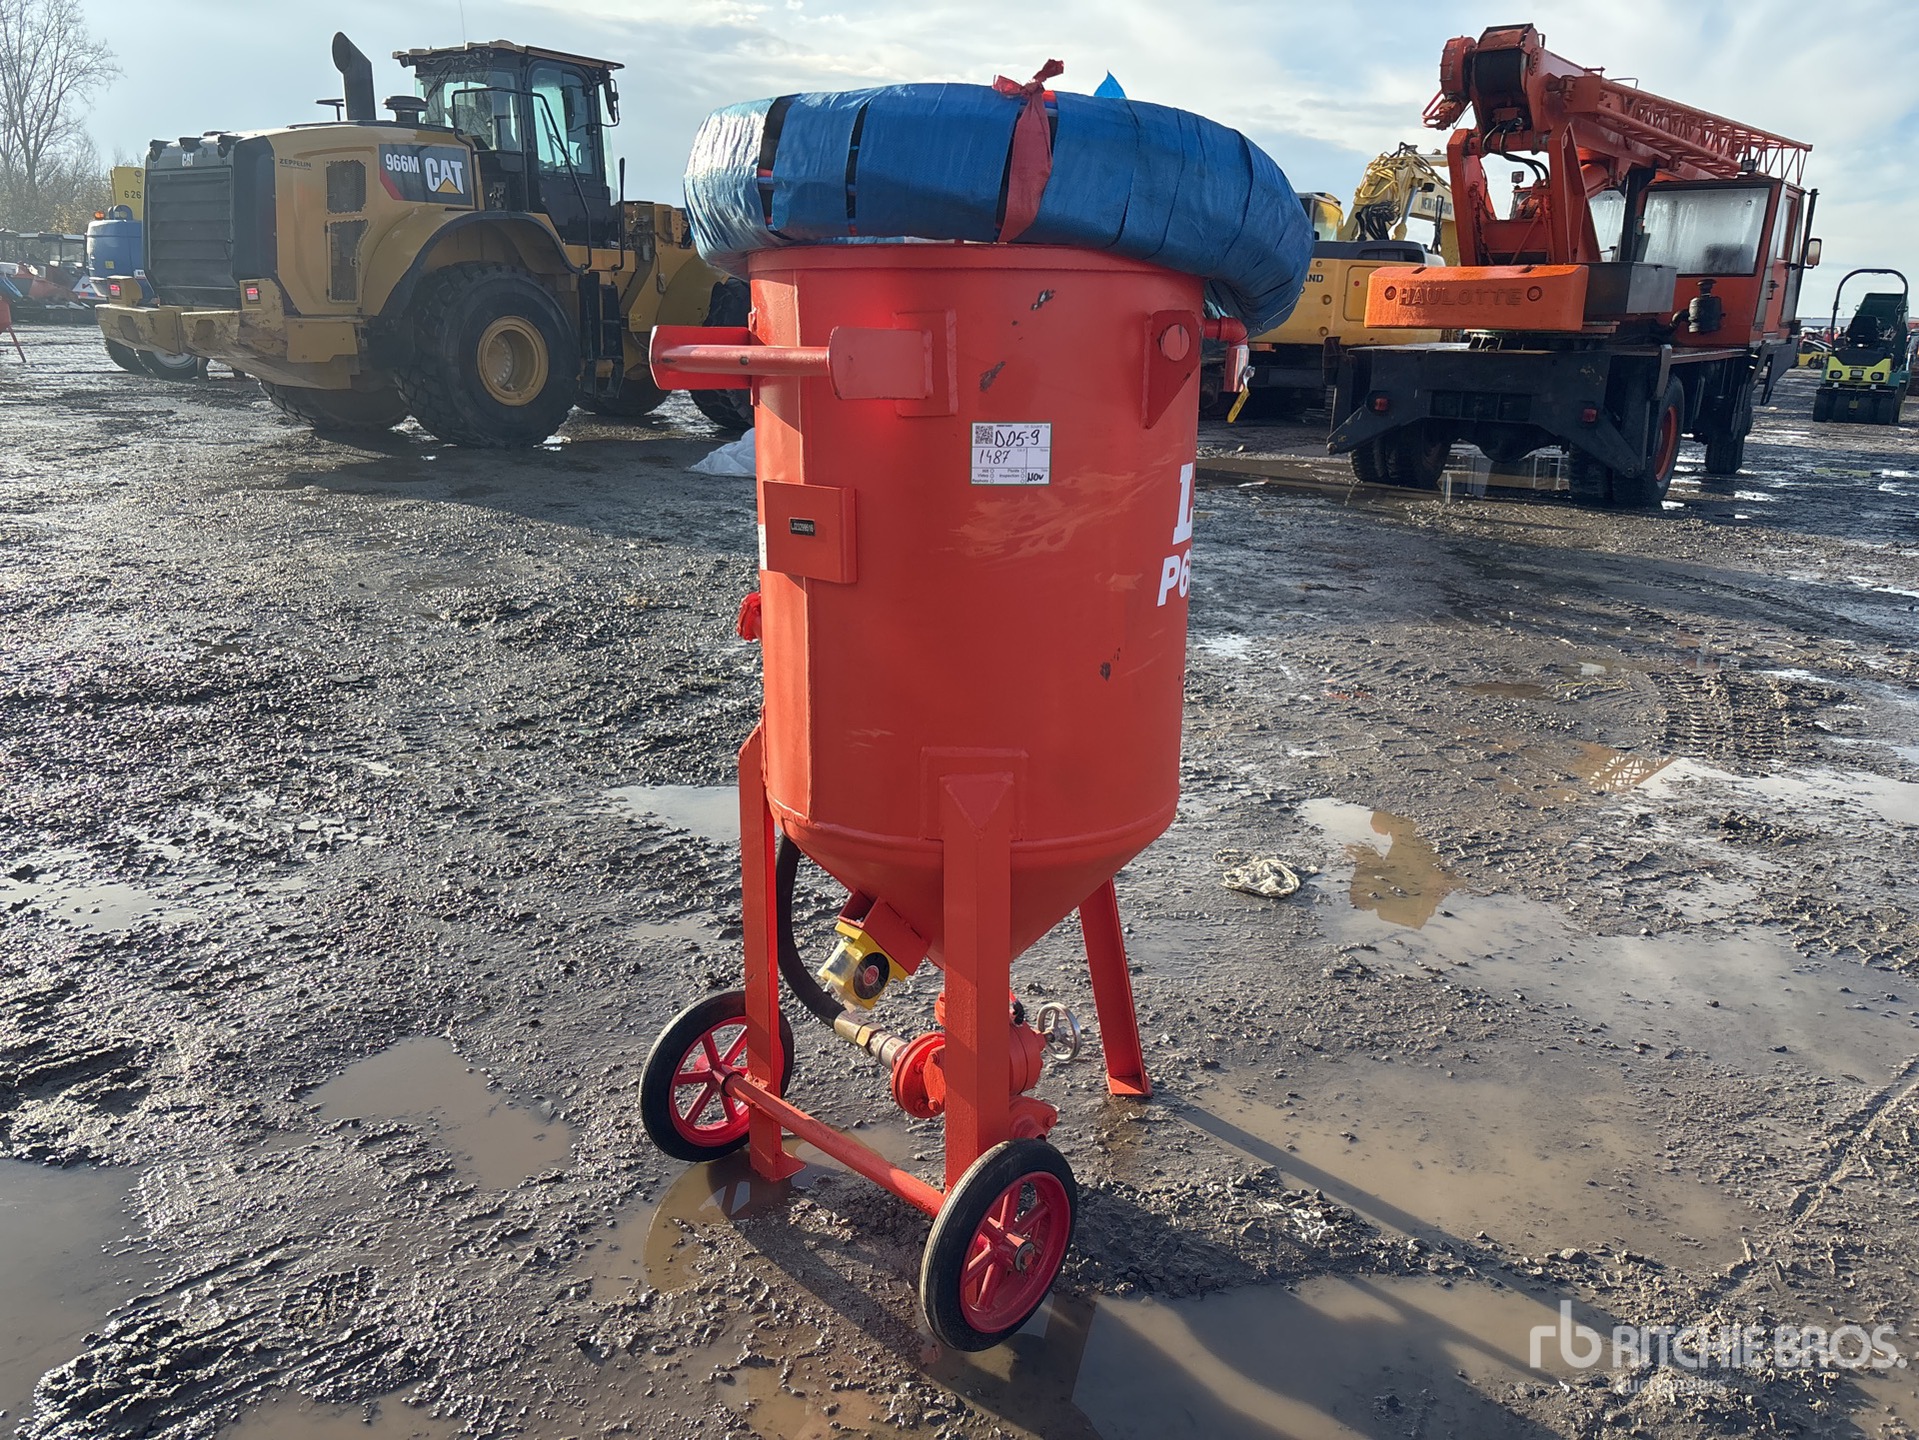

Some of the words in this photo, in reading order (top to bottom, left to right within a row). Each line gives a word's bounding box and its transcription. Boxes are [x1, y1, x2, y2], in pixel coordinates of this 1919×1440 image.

[181, 153, 194, 166] CAT
[279, 158, 312, 168] ZEPPELIN
[385, 153, 420, 174] 966M
[425, 157, 464, 195] CAT
[124, 190, 142, 199] 626
[1398, 286, 1523, 306] HAULOTTE
[979, 449, 1011, 465] 1487
[1157, 549, 1190, 607] P6
